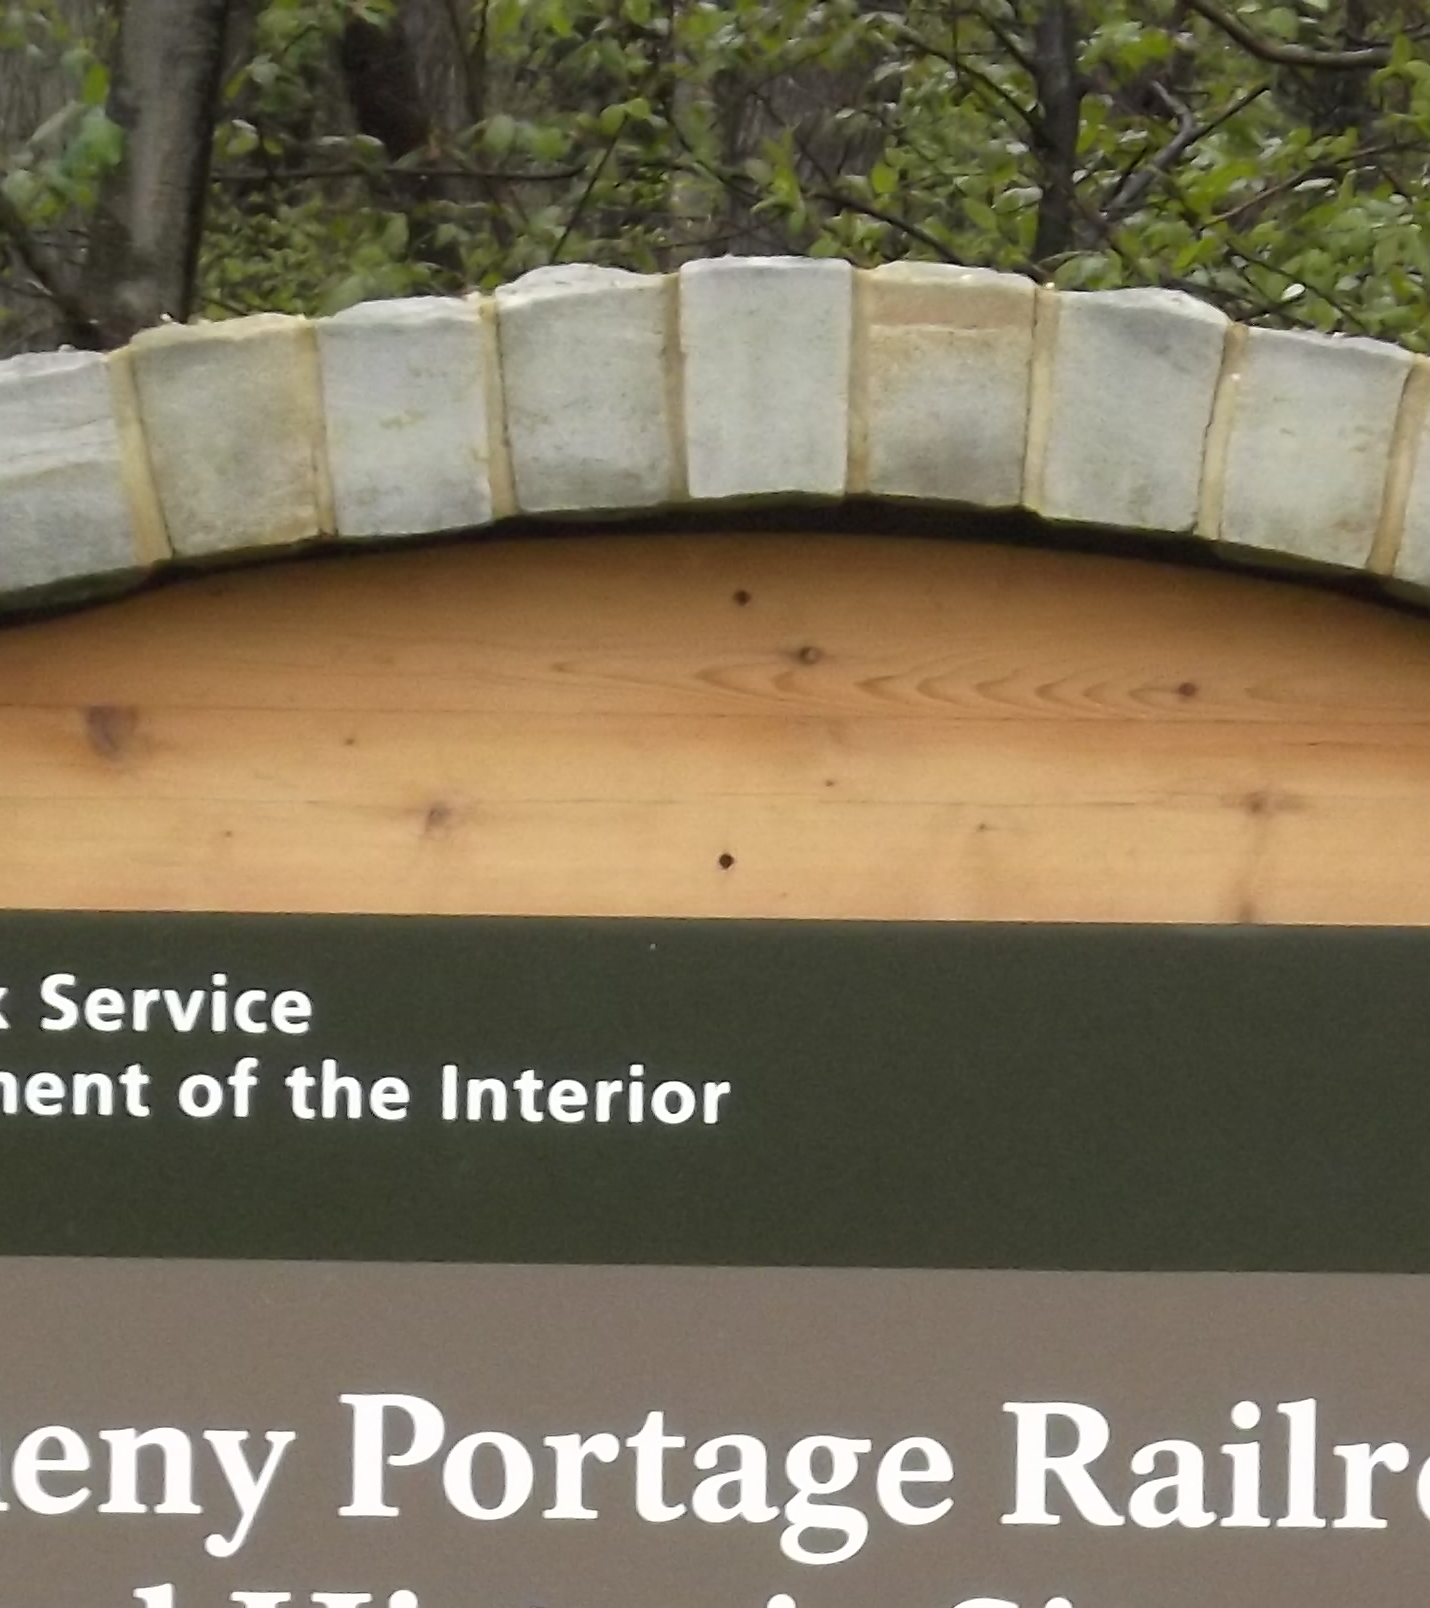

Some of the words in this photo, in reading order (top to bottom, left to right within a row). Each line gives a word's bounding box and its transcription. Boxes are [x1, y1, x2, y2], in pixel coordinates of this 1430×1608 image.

[40, 973, 313, 1035] Service
[178, 1057, 259, 1118] of
[284, 1058, 411, 1121] the
[442, 1064, 731, 1125] Interior
[338, 1394, 954, 1566] Portage
